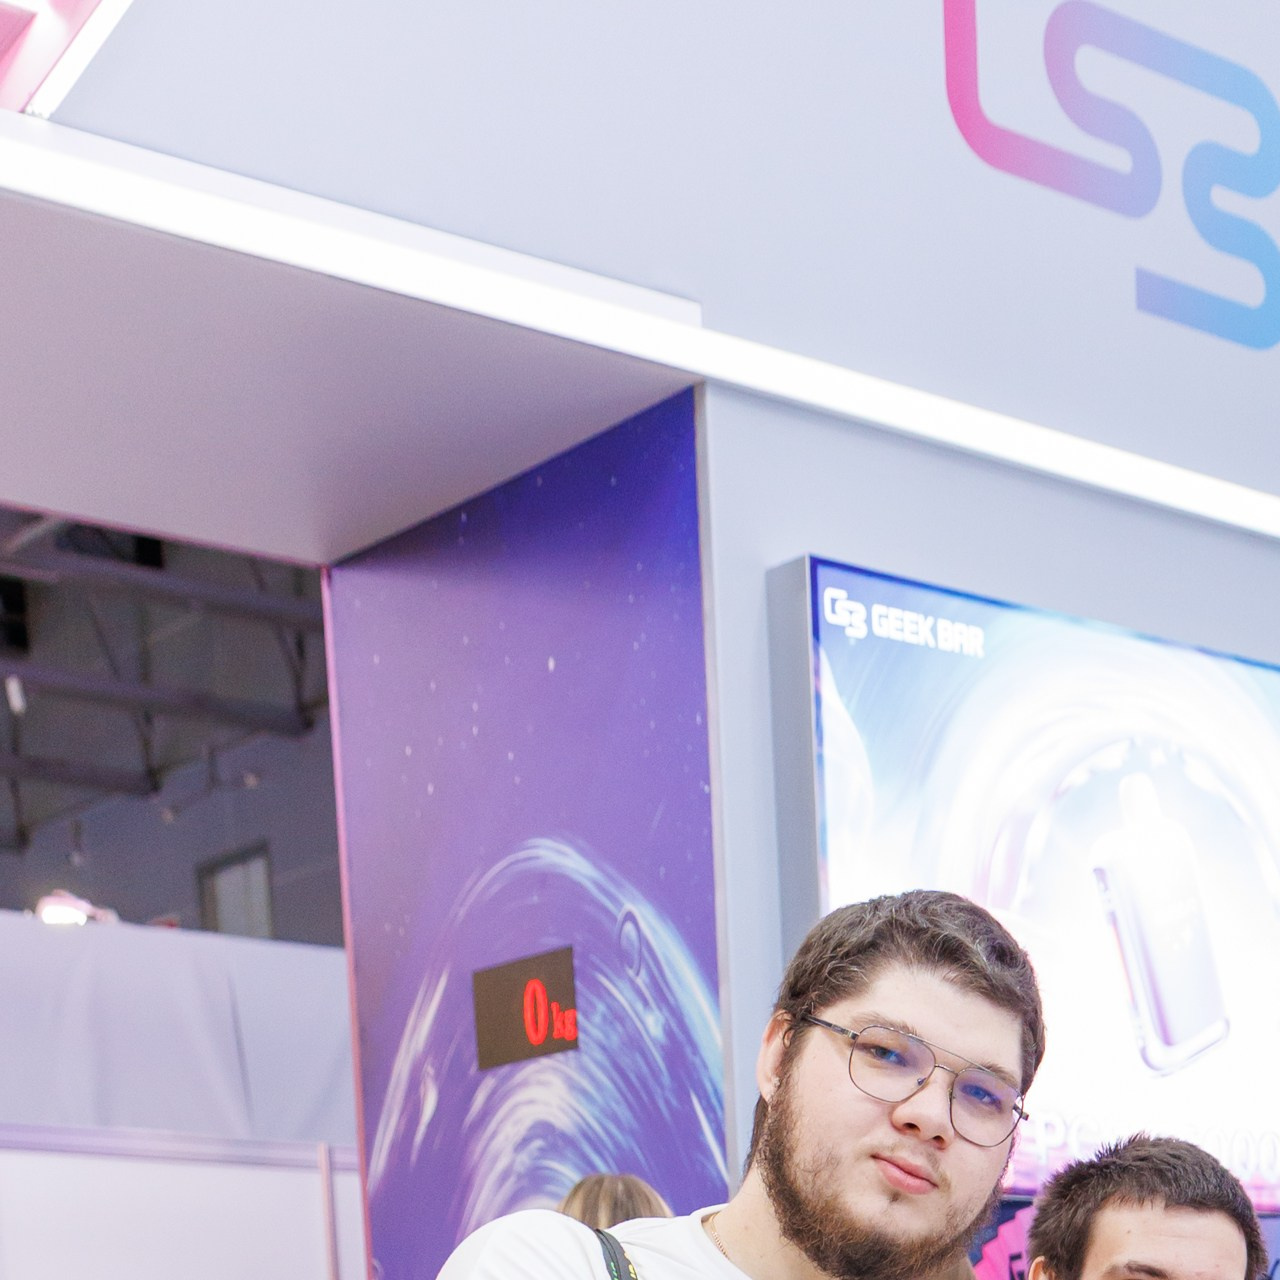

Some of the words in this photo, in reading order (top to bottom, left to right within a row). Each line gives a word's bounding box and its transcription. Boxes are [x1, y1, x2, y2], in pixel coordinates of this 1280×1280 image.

[871, 603, 936, 649] GEEK
[936, 617, 986, 660] BAR
[523, 978, 549, 1046] 0
